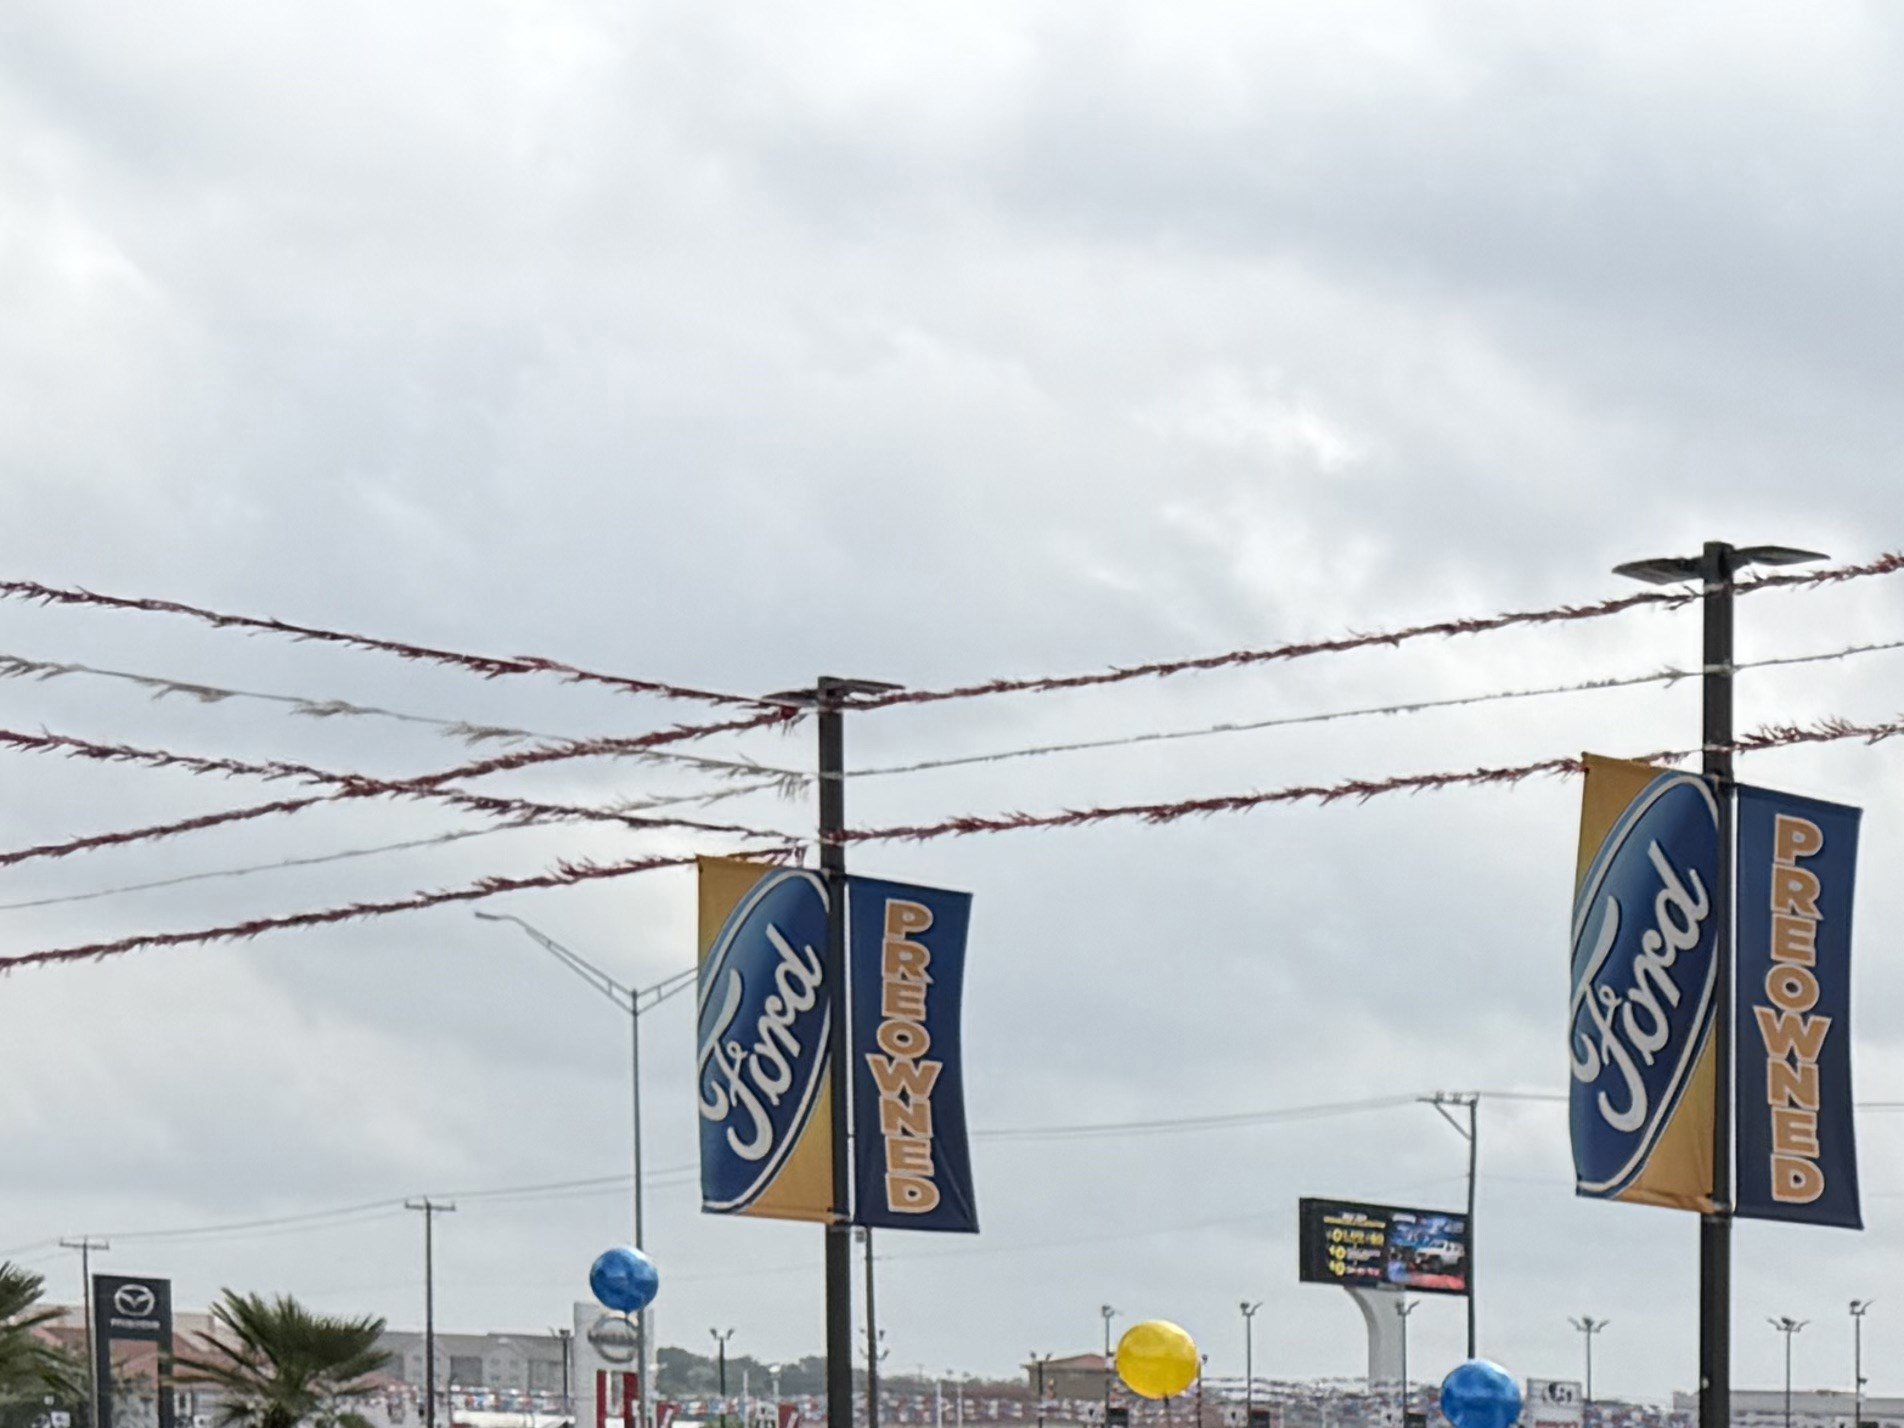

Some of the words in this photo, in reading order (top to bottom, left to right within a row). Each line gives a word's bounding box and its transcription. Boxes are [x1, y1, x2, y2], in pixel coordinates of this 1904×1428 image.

[699, 923, 823, 1162] Ford
[865, 899, 942, 1215] PREOWNED
[1570, 839, 1710, 1133] Ford
[1752, 813, 1832, 1204] PREOWNED
